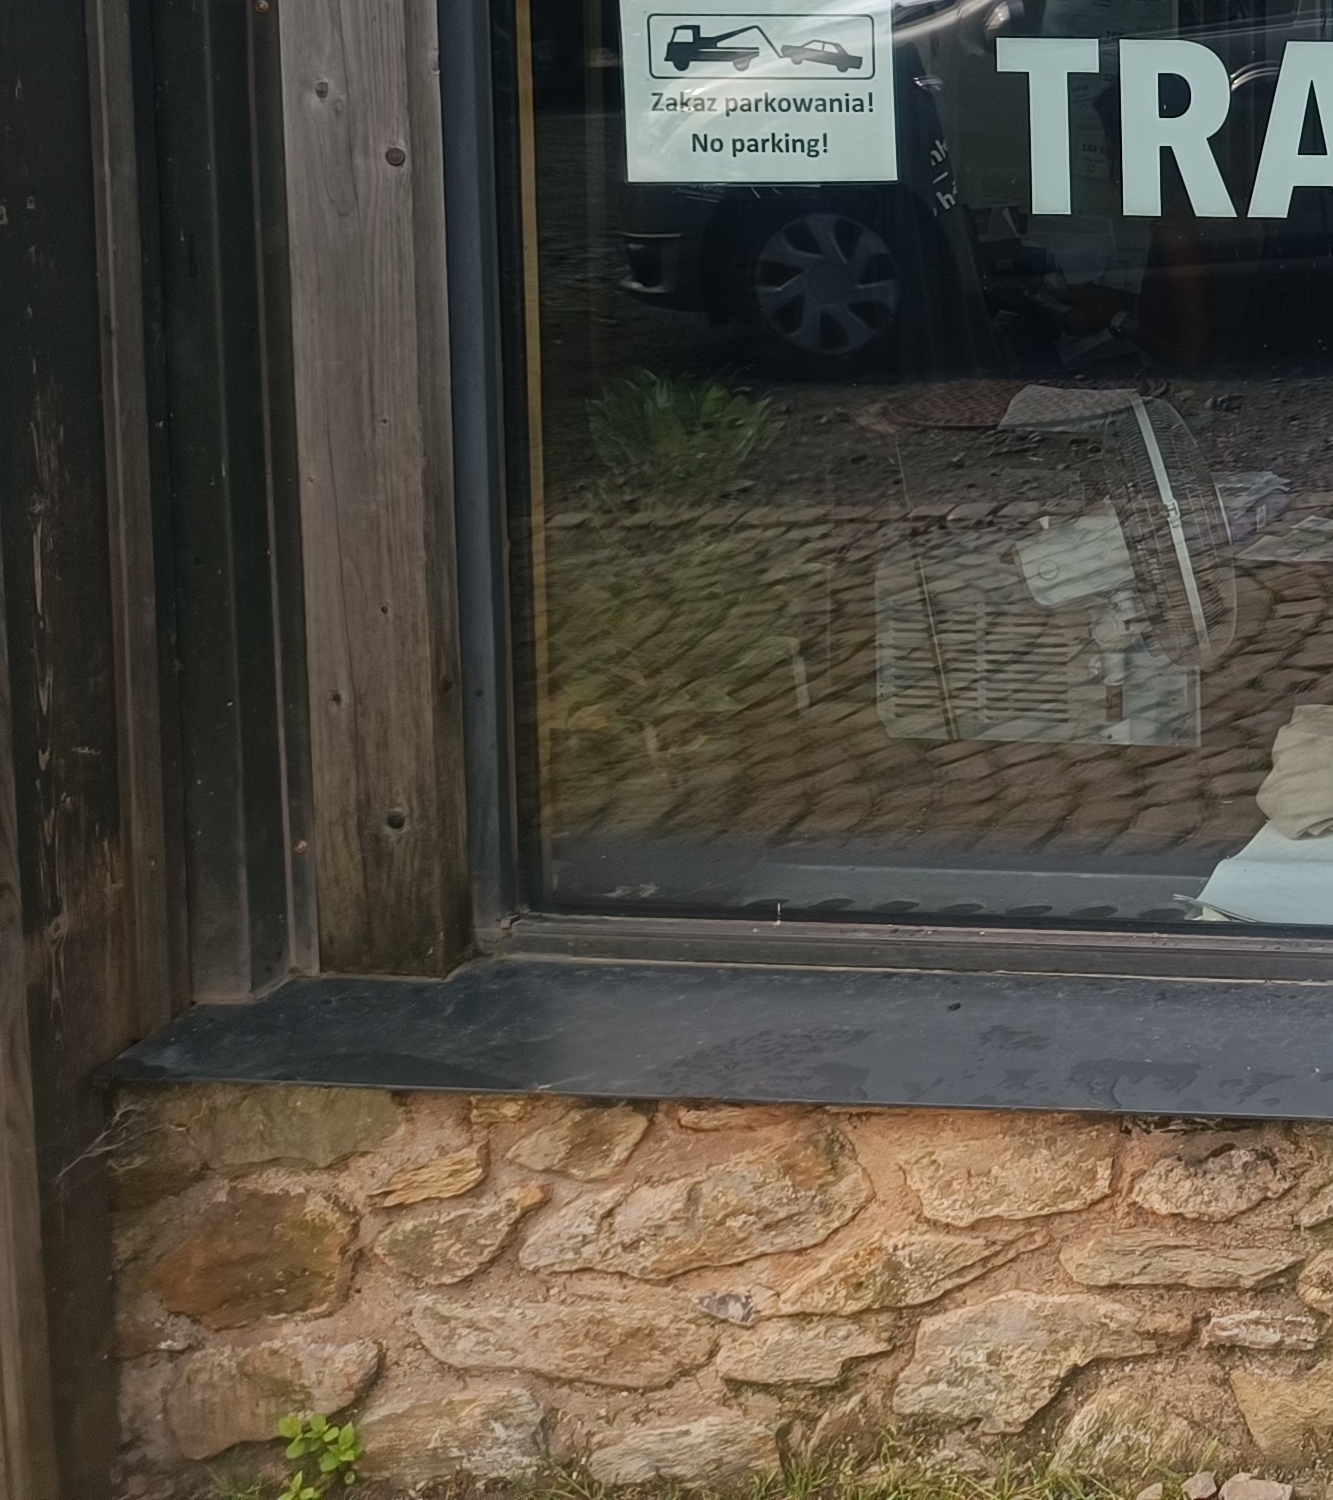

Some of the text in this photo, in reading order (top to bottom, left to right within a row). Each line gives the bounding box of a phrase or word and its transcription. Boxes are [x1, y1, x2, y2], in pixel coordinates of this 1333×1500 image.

[651, 91, 874, 117] Zakaz parkowania!
[691, 133, 828, 157] No parking!
